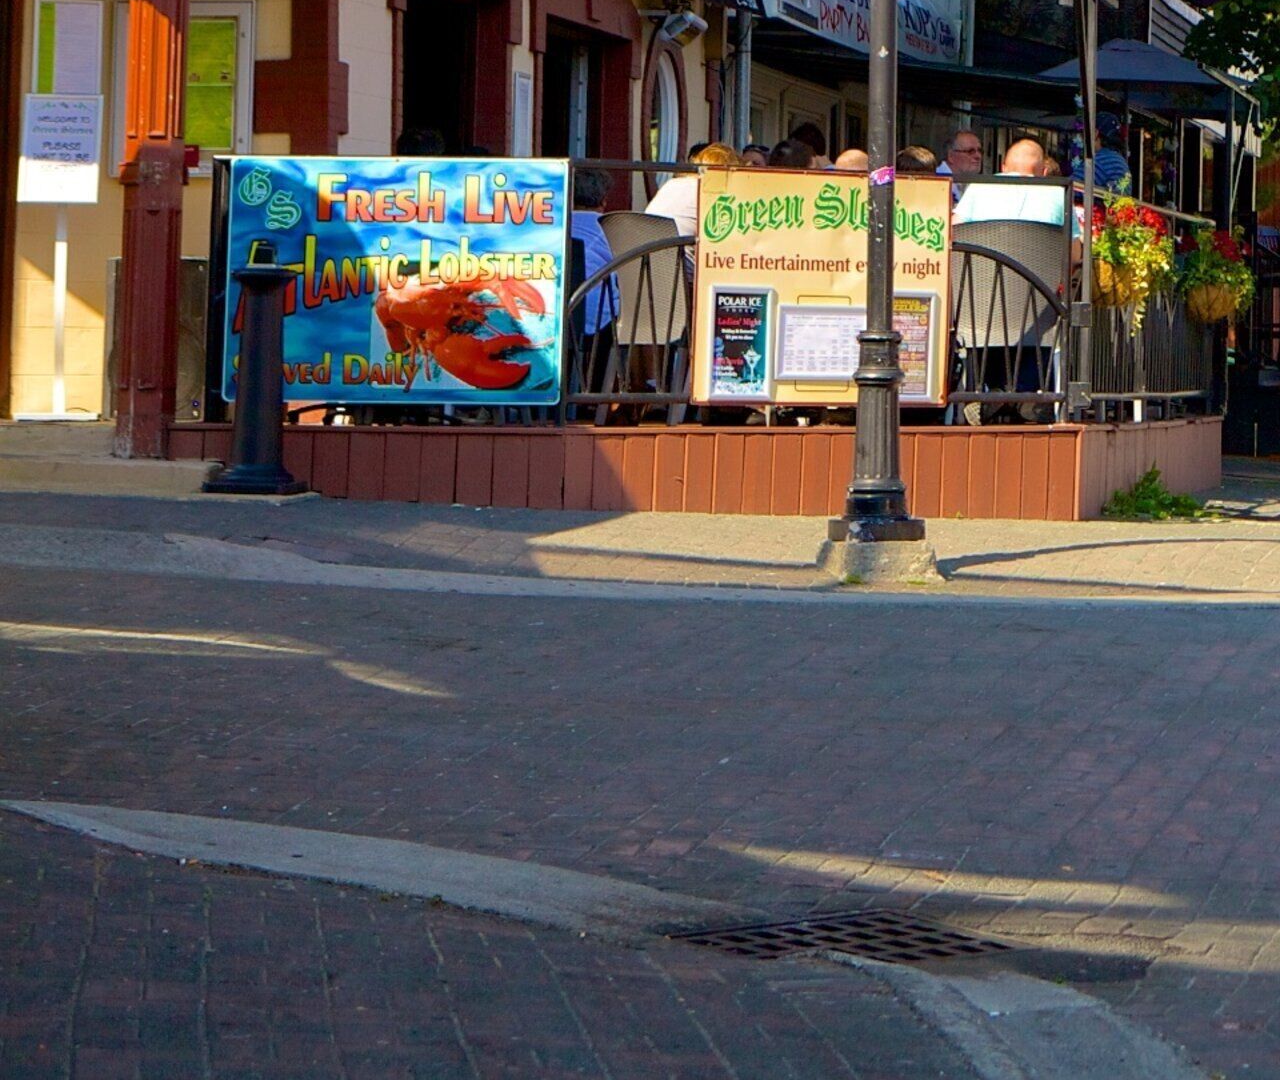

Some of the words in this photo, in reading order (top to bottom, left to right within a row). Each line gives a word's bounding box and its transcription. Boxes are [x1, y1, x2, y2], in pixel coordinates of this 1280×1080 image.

[819, 0, 853, 35] PARTY
[42, 141, 81, 151] PLEASE
[704, 193, 805, 243] Green
[813, 183, 946, 253] Sleves
[706, 251, 735, 270] Live
[740, 253, 851, 273] Entertainment
[902, 258, 941, 280] night
[718, 296, 748, 306] POLAR
[749, 297, 762, 307] ICE
